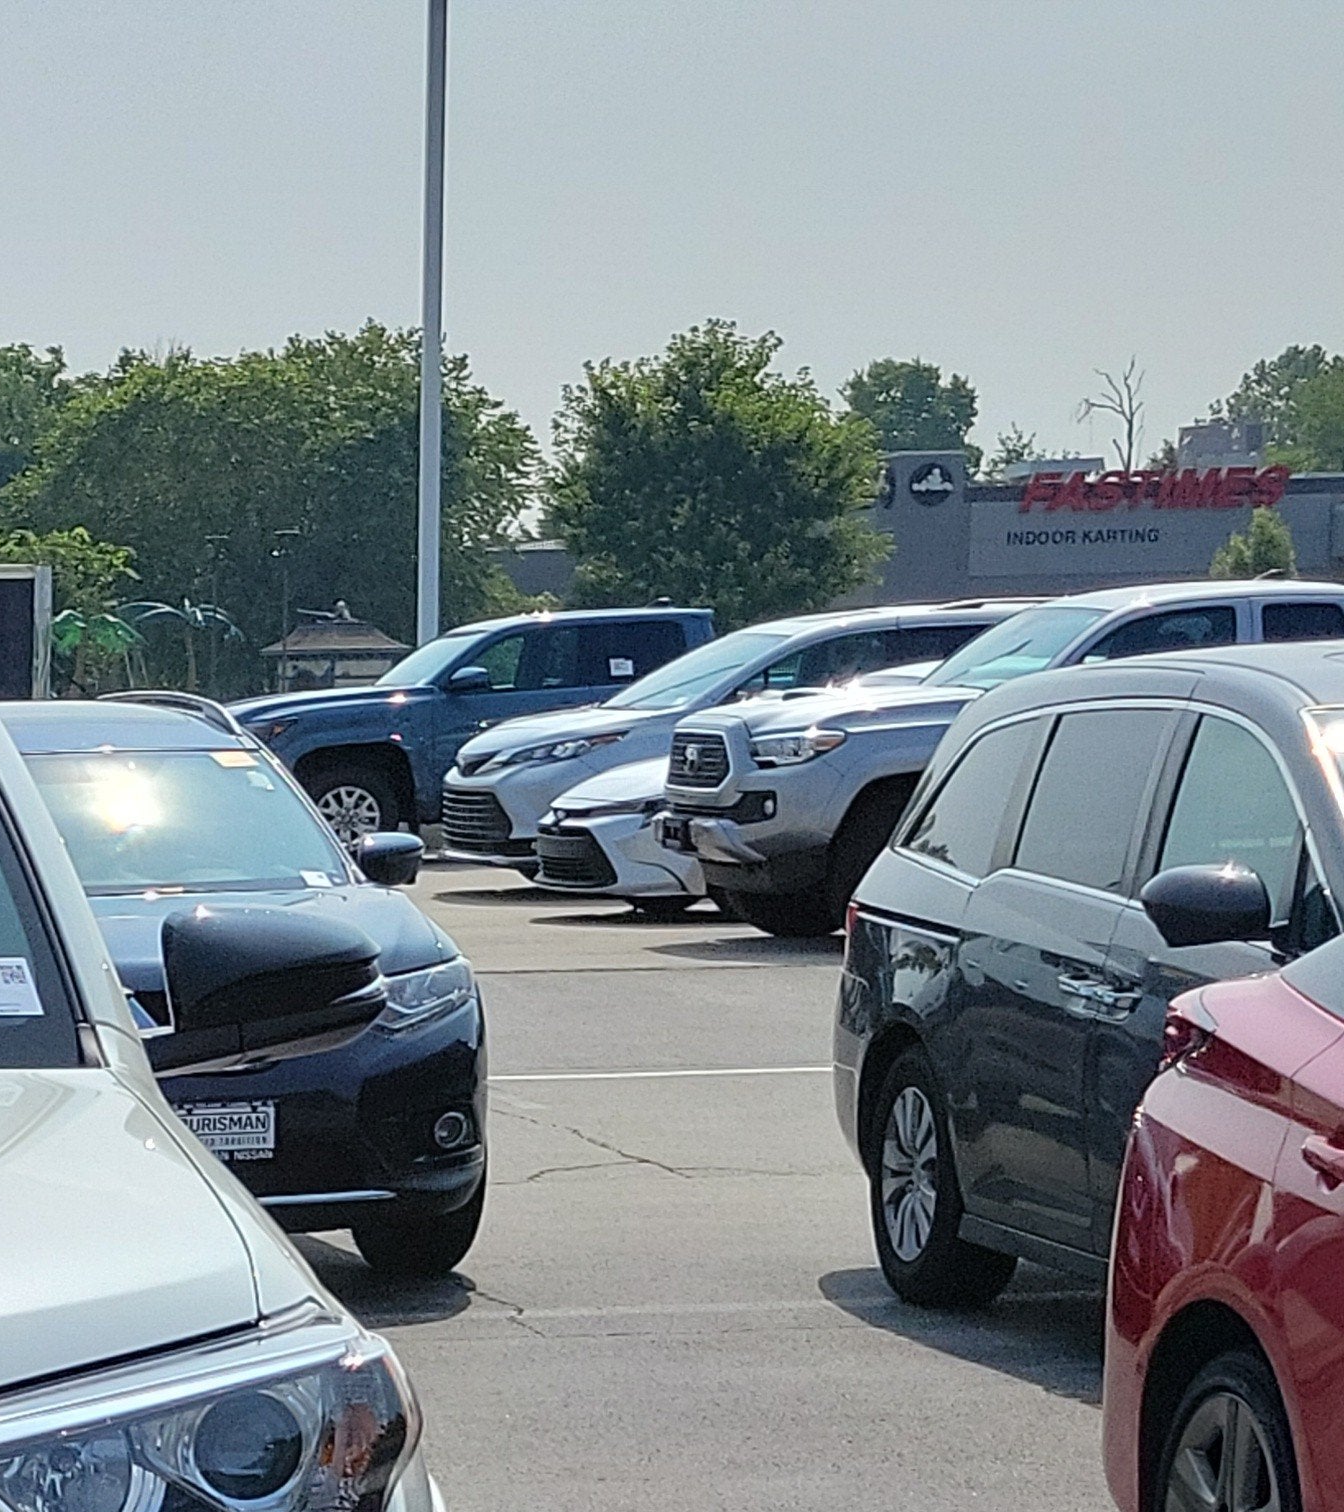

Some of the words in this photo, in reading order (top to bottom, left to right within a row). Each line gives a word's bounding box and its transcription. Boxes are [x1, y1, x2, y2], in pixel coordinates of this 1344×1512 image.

[1018, 465, 1291, 513] FASTIMES
[1007, 529, 1076, 546] INDOOR
[1081, 527, 1160, 544] KARTING
[233, 1149, 274, 1161] NISSAN
